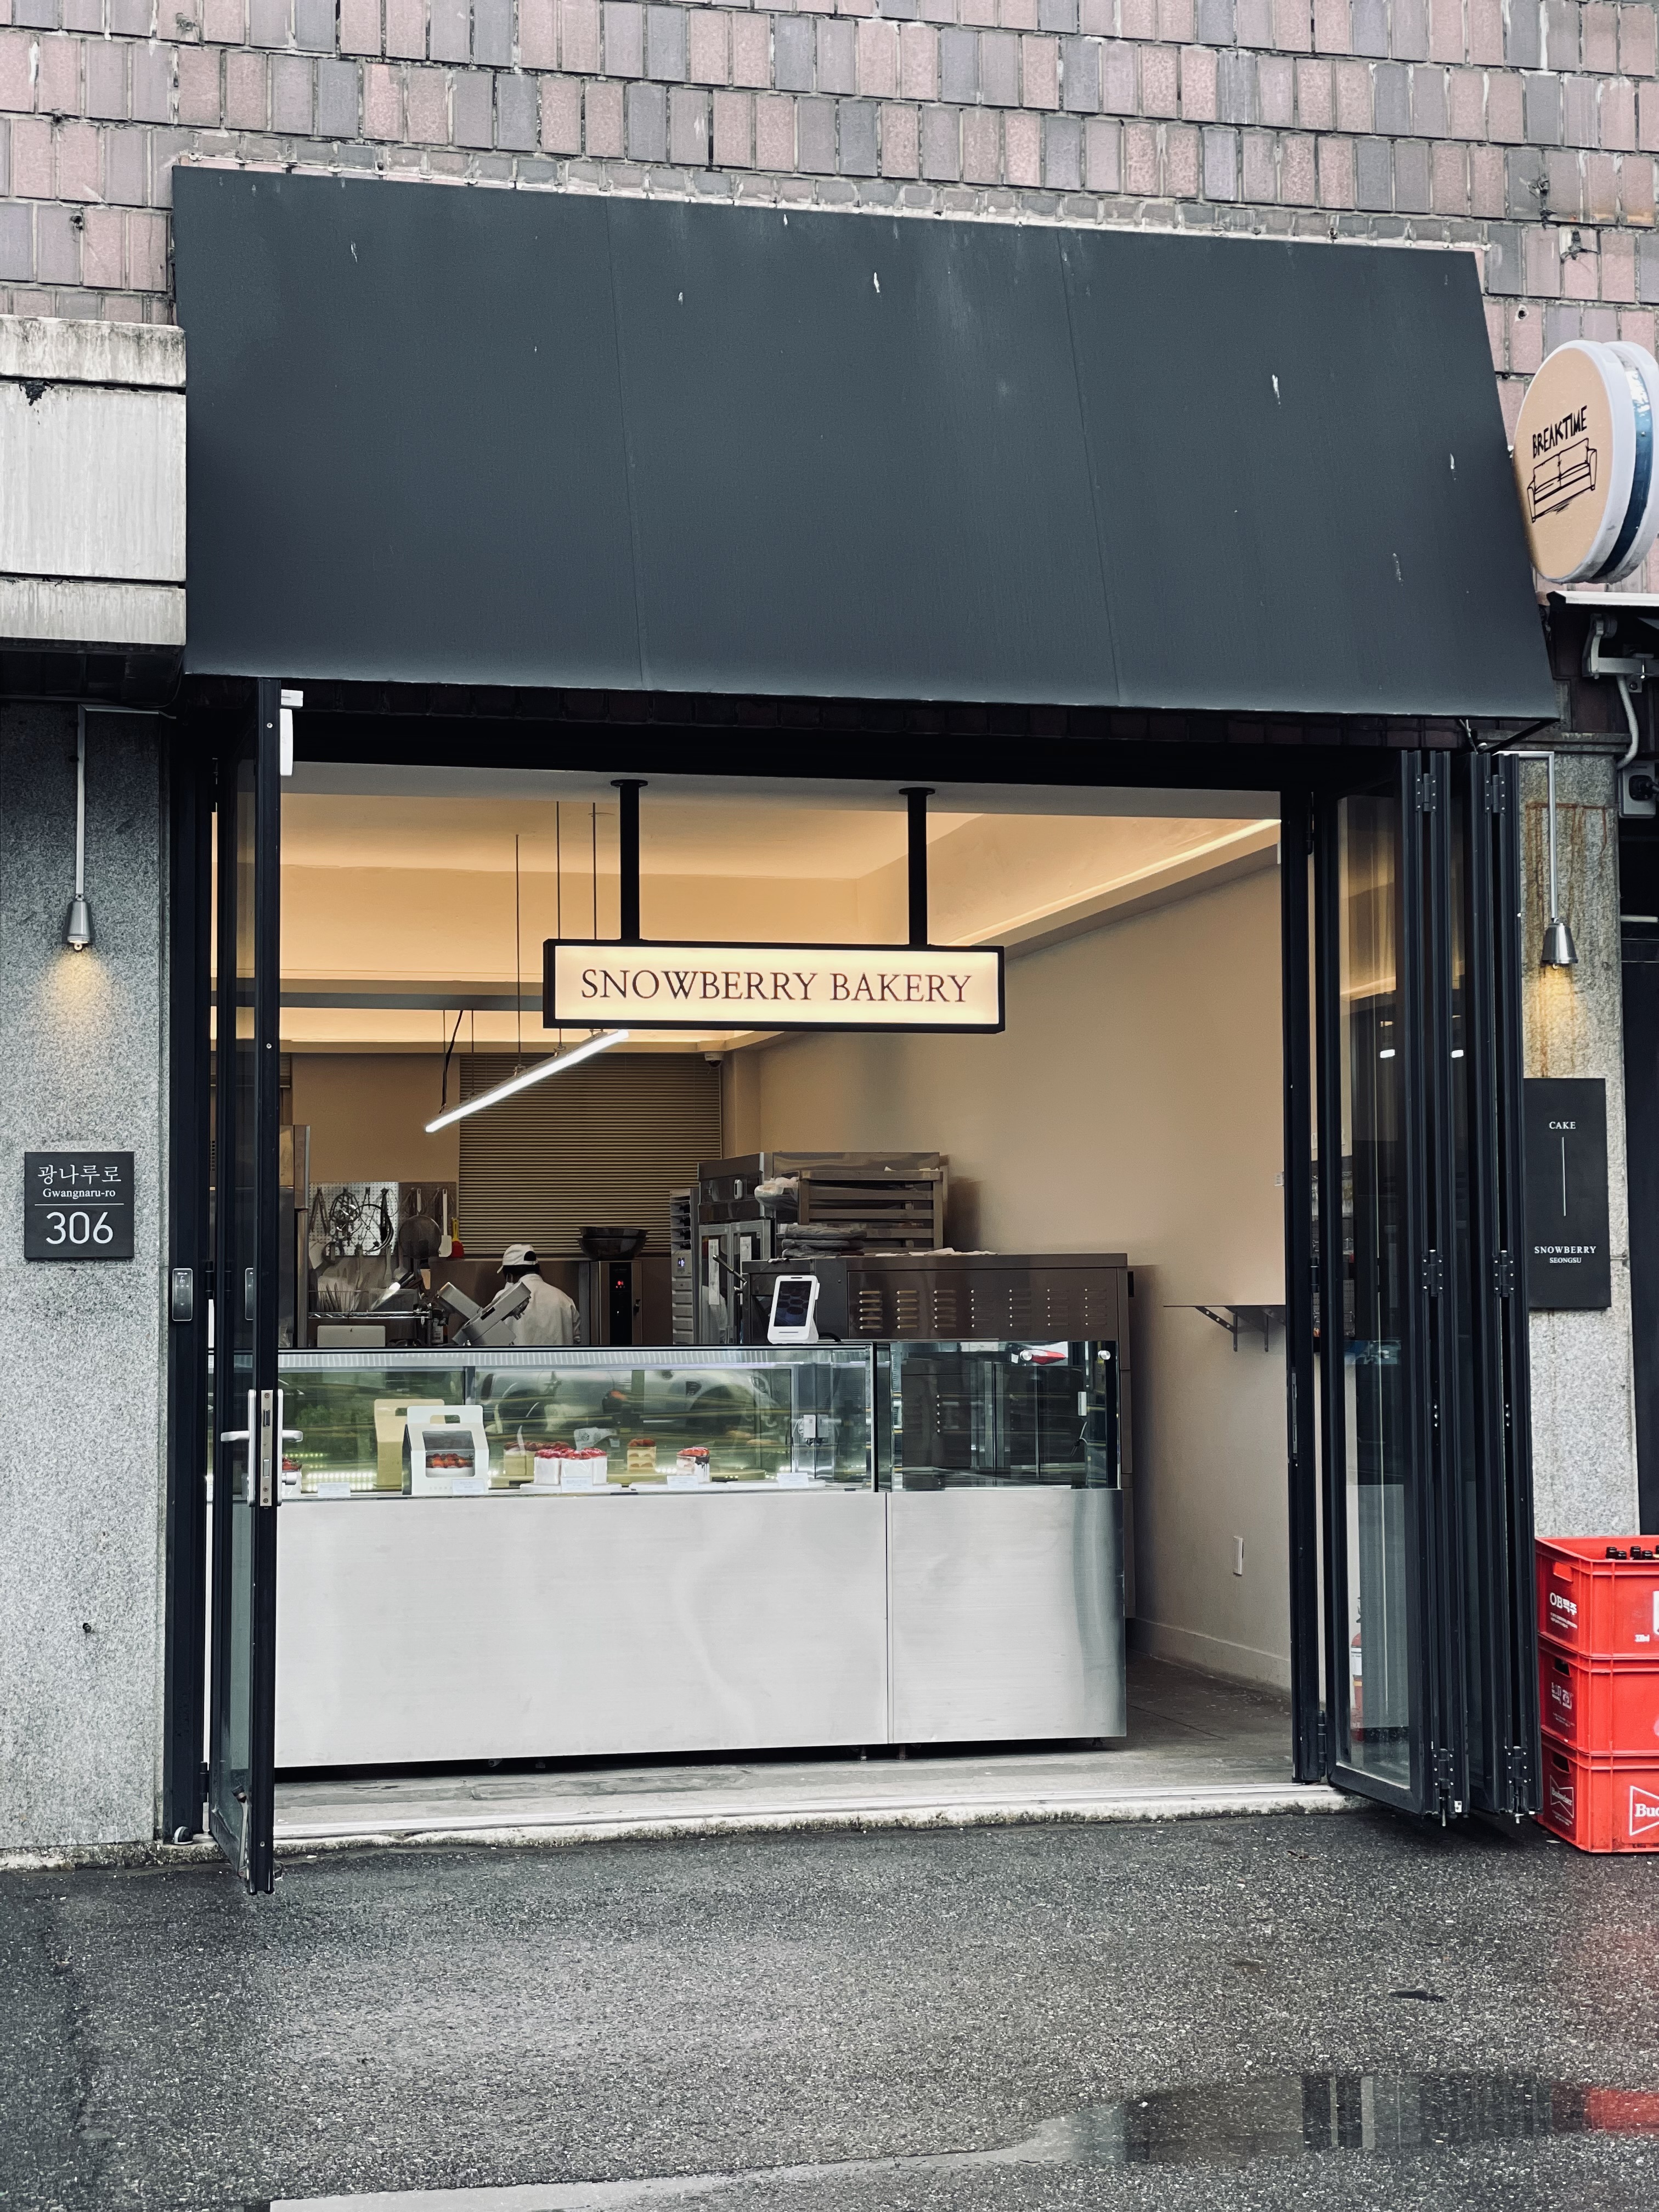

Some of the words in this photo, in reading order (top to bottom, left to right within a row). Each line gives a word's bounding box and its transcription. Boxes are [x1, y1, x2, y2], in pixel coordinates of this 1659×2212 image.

[1532, 405, 1587, 459] BREAKTIME
[581, 969, 818, 1001] SNOWBERRY
[830, 972, 972, 1002] BAKERY
[1549, 1121, 1576, 1130] CAKE
[37, 1164, 122, 1185] 광나루로
[42, 1188, 116, 1200] Gwangnaru-ro
[46, 1211, 114, 1244] 306
[1534, 1246, 1596, 1254] SNOWBERRY
